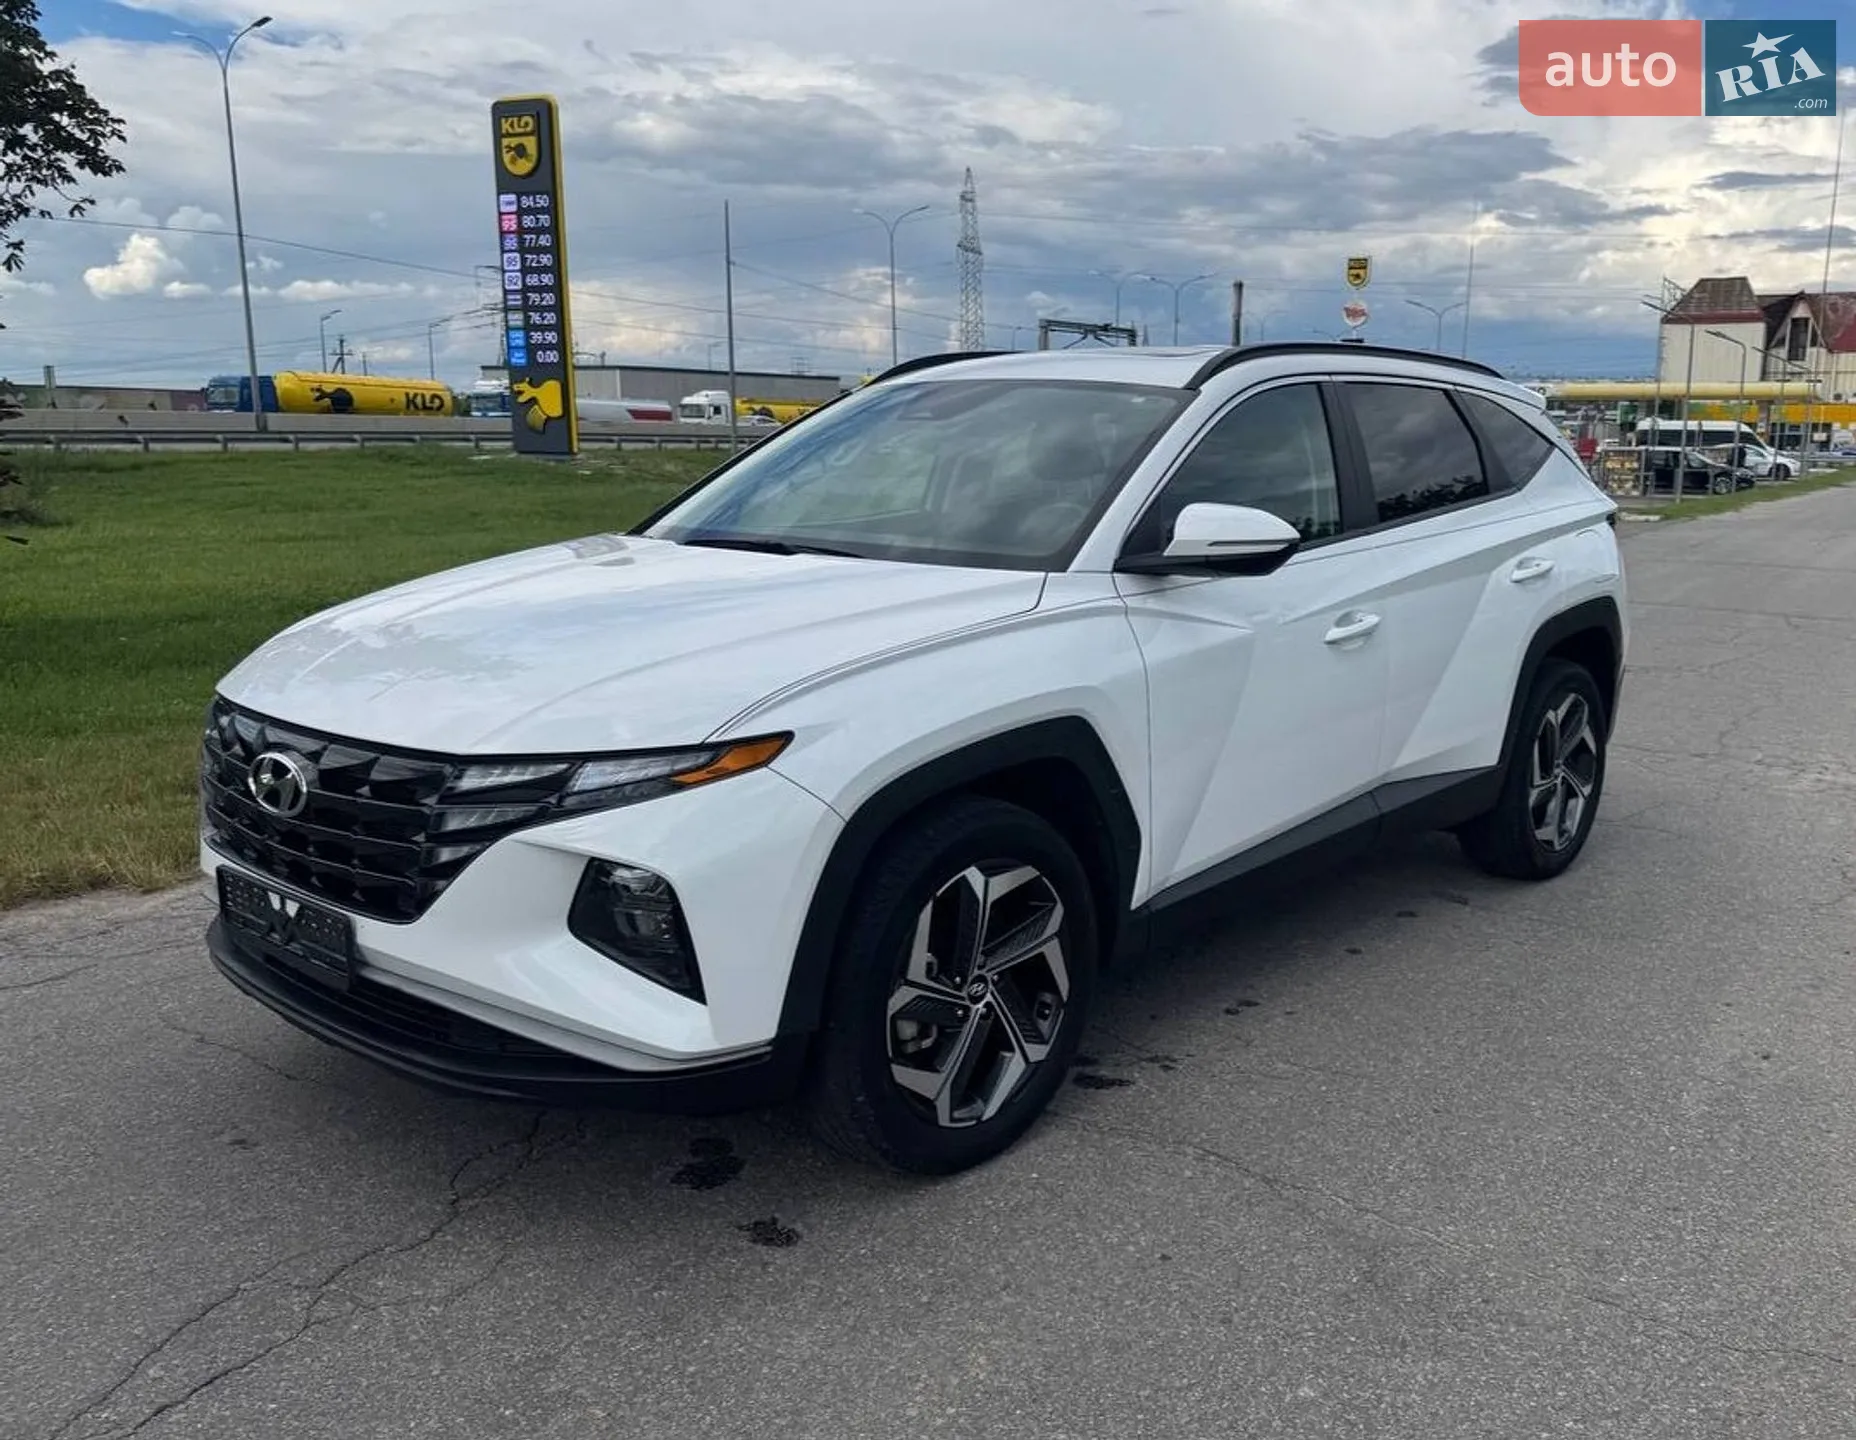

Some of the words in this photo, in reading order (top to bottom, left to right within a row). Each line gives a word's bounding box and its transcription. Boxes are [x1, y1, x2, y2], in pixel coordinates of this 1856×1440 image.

[501, 116, 534, 134] KLO
[521, 194, 549, 208] 84.50
[522, 214, 551, 228] 80.70
[523, 234, 552, 247] 77.40
[523, 253, 553, 267] 72.90
[525, 272, 554, 286] 68.90
[527, 293, 556, 305] 79.20
[527, 311, 557, 325] 76.20
[528, 330, 558, 344] 39.90
[536, 350, 559, 363] 0.00
[404, 391, 445, 412] KLO
